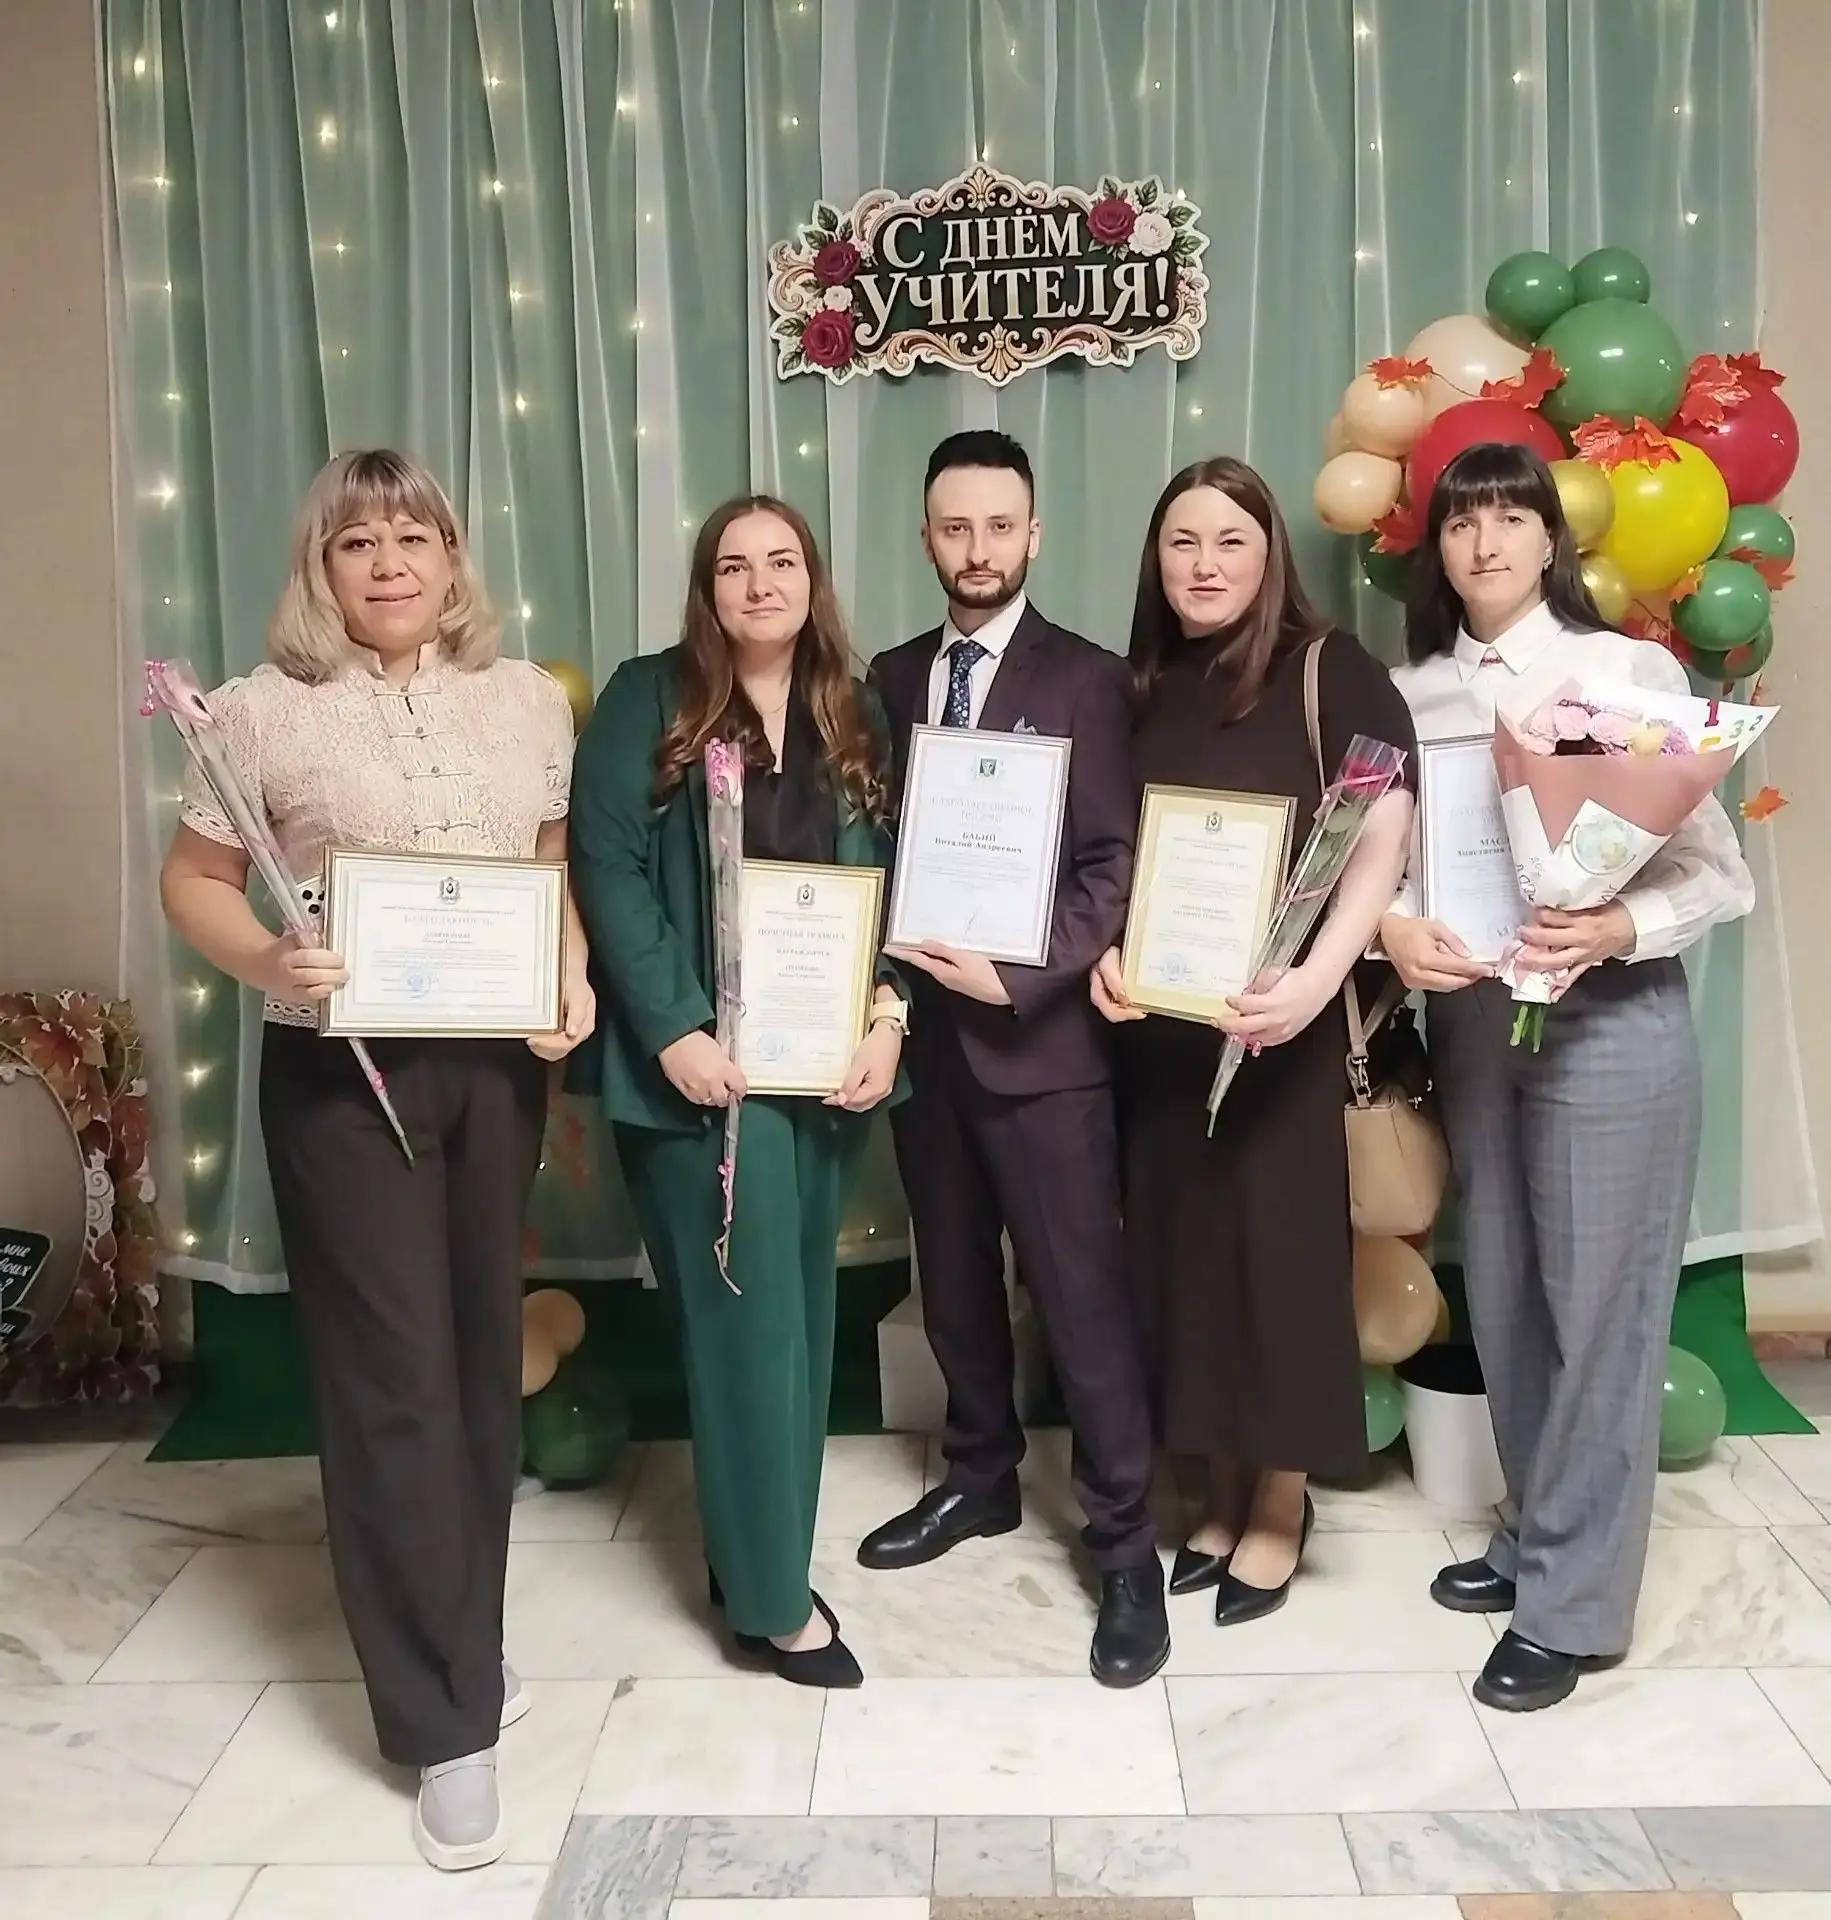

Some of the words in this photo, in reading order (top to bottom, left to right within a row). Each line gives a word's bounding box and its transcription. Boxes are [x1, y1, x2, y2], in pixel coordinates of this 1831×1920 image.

[881, 215, 926, 270] С
[940, 207, 1082, 271] ДНЁМ
[855, 256, 1170, 347] УЧИТЕЛЯ!
